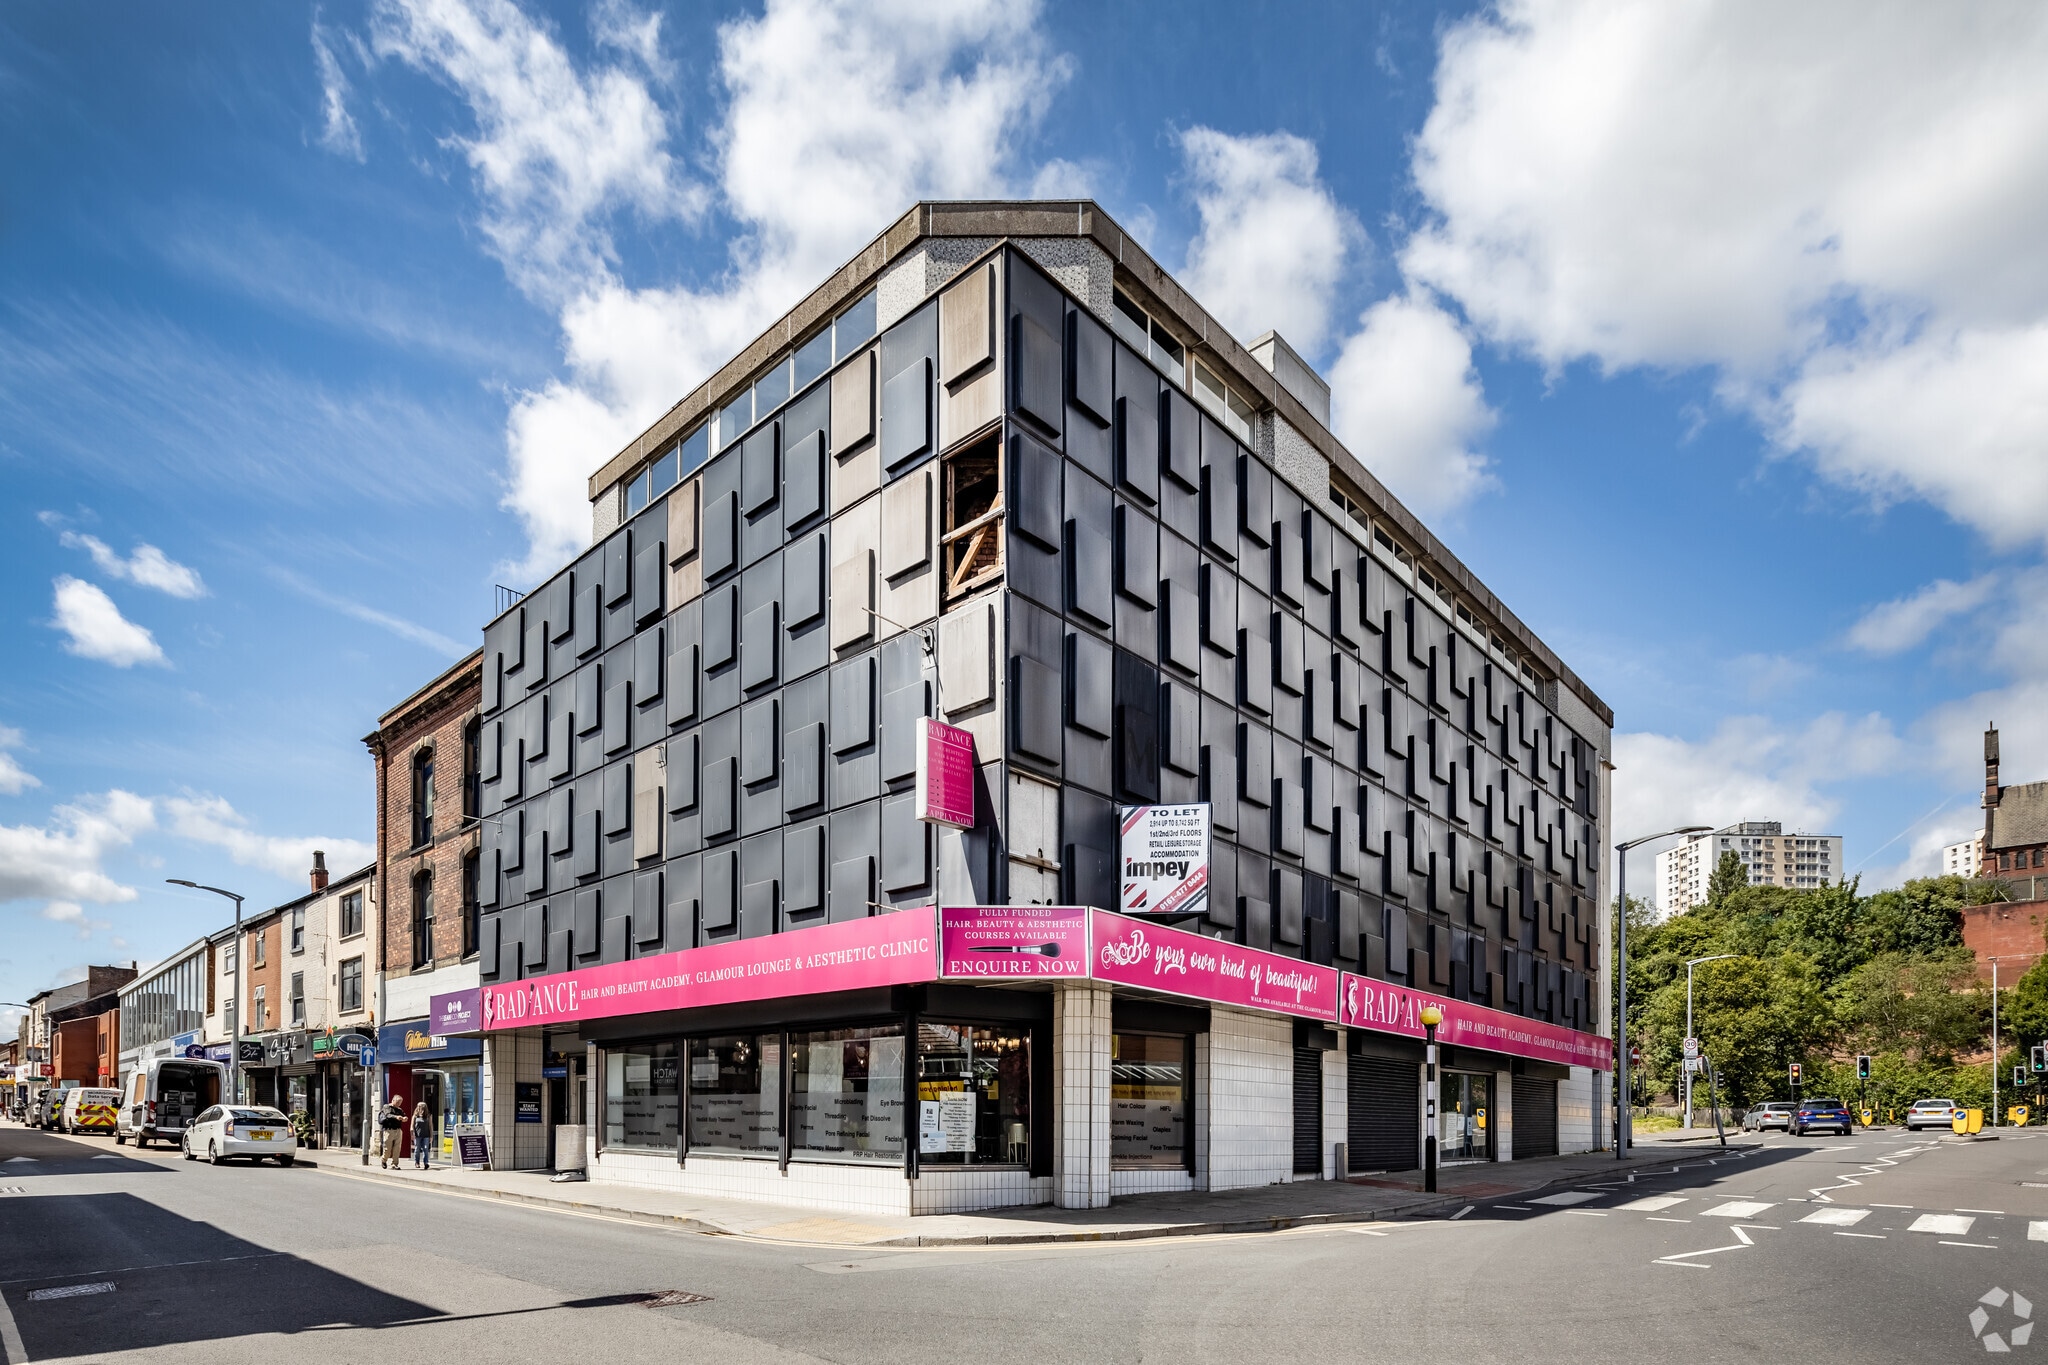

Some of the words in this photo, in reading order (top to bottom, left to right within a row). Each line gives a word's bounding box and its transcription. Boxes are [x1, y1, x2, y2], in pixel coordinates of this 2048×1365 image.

[930, 809, 952, 822] APPLY
[955, 816, 972, 826] NOW
[1150, 850, 1200, 858] ACCOMMODATION
[1126, 858, 1190, 881] impey
[1160, 884, 1188, 910] 0161-477
[1187, 872, 1204, 887] 0444
[581, 988, 599, 1000] HAIR
[600, 985, 616, 998] AND
[618, 980, 648, 994] BEAUTY
[650, 973, 693, 990] ACADEMY,
[696, 965, 745, 984] GLAMOUR
[747, 958, 791, 976] LOUNGE
[795, 956, 802, 970] &
[806, 945, 876, 969] AESTHETIC
[879, 937, 928, 958] CLINIC
[950, 960, 1031, 974] ENQUIRE
[1038, 960, 1080, 973] NOW
[1128, 930, 1150, 964] Be
[1154, 944, 1186, 975] your
[1190, 952, 1216, 972] own
[1220, 954, 1246, 980] kind
[1250, 964, 1263, 995] of
[1266, 970, 1318, 1003] beautiful!
[496, 980, 579, 1021] RADIANCE
[1270, 999, 1291, 1008] AVAILABLE
[1304, 1005, 1321, 1013] GLAMOUR
[1363, 986, 1446, 1034] RADIANE
[431, 1037, 447, 1048] HILL
[1457, 1019, 1473, 1032] HAIR
[1474, 1021, 1486, 1035] AND
[1487, 1023, 1508, 1039] BEAUTY
[1508, 1030, 1532, 1045] ACADEMY,
[1534, 1035, 1555, 1049] GLAMOUR
[1556, 1040, 1573, 1053] LOUNGE
